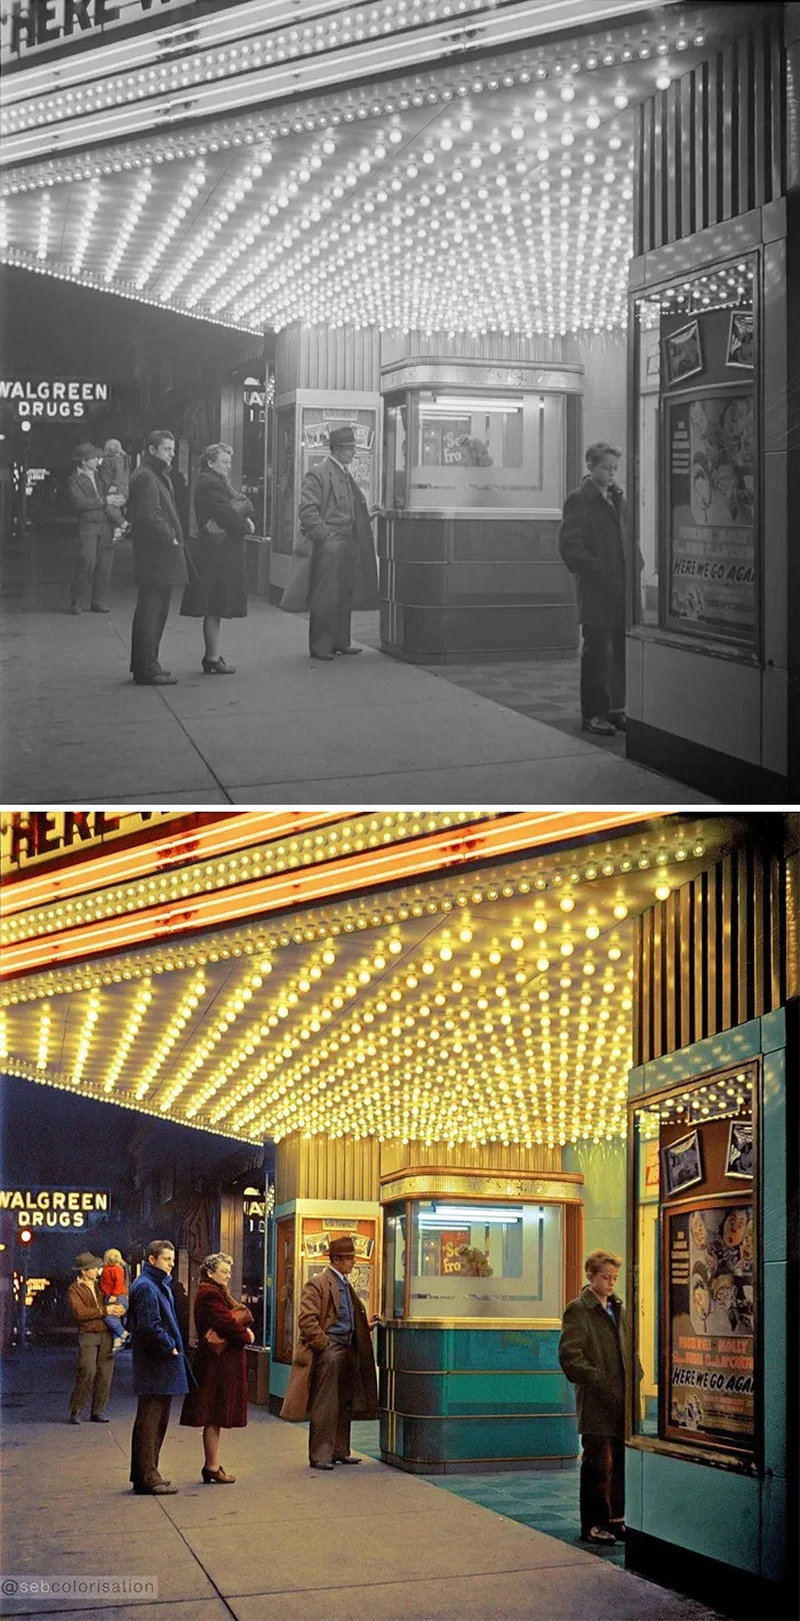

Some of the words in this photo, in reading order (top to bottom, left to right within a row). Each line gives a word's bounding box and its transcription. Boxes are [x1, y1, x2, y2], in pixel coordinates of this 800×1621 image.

[0, 381, 107, 400] WALGREEN
[18, 401, 84, 417] DRUGS
[673, 557, 696, 576] HERE
[697, 562, 709, 578] WE
[710, 563, 725, 579] GO
[0, 1190, 107, 1210] WALGREEN
[18, 1211, 84, 1227] DRUGS
[672, 1367, 696, 1386] HERE
[697, 1371, 709, 1388] WE
[710, 1373, 725, 1390] GO
